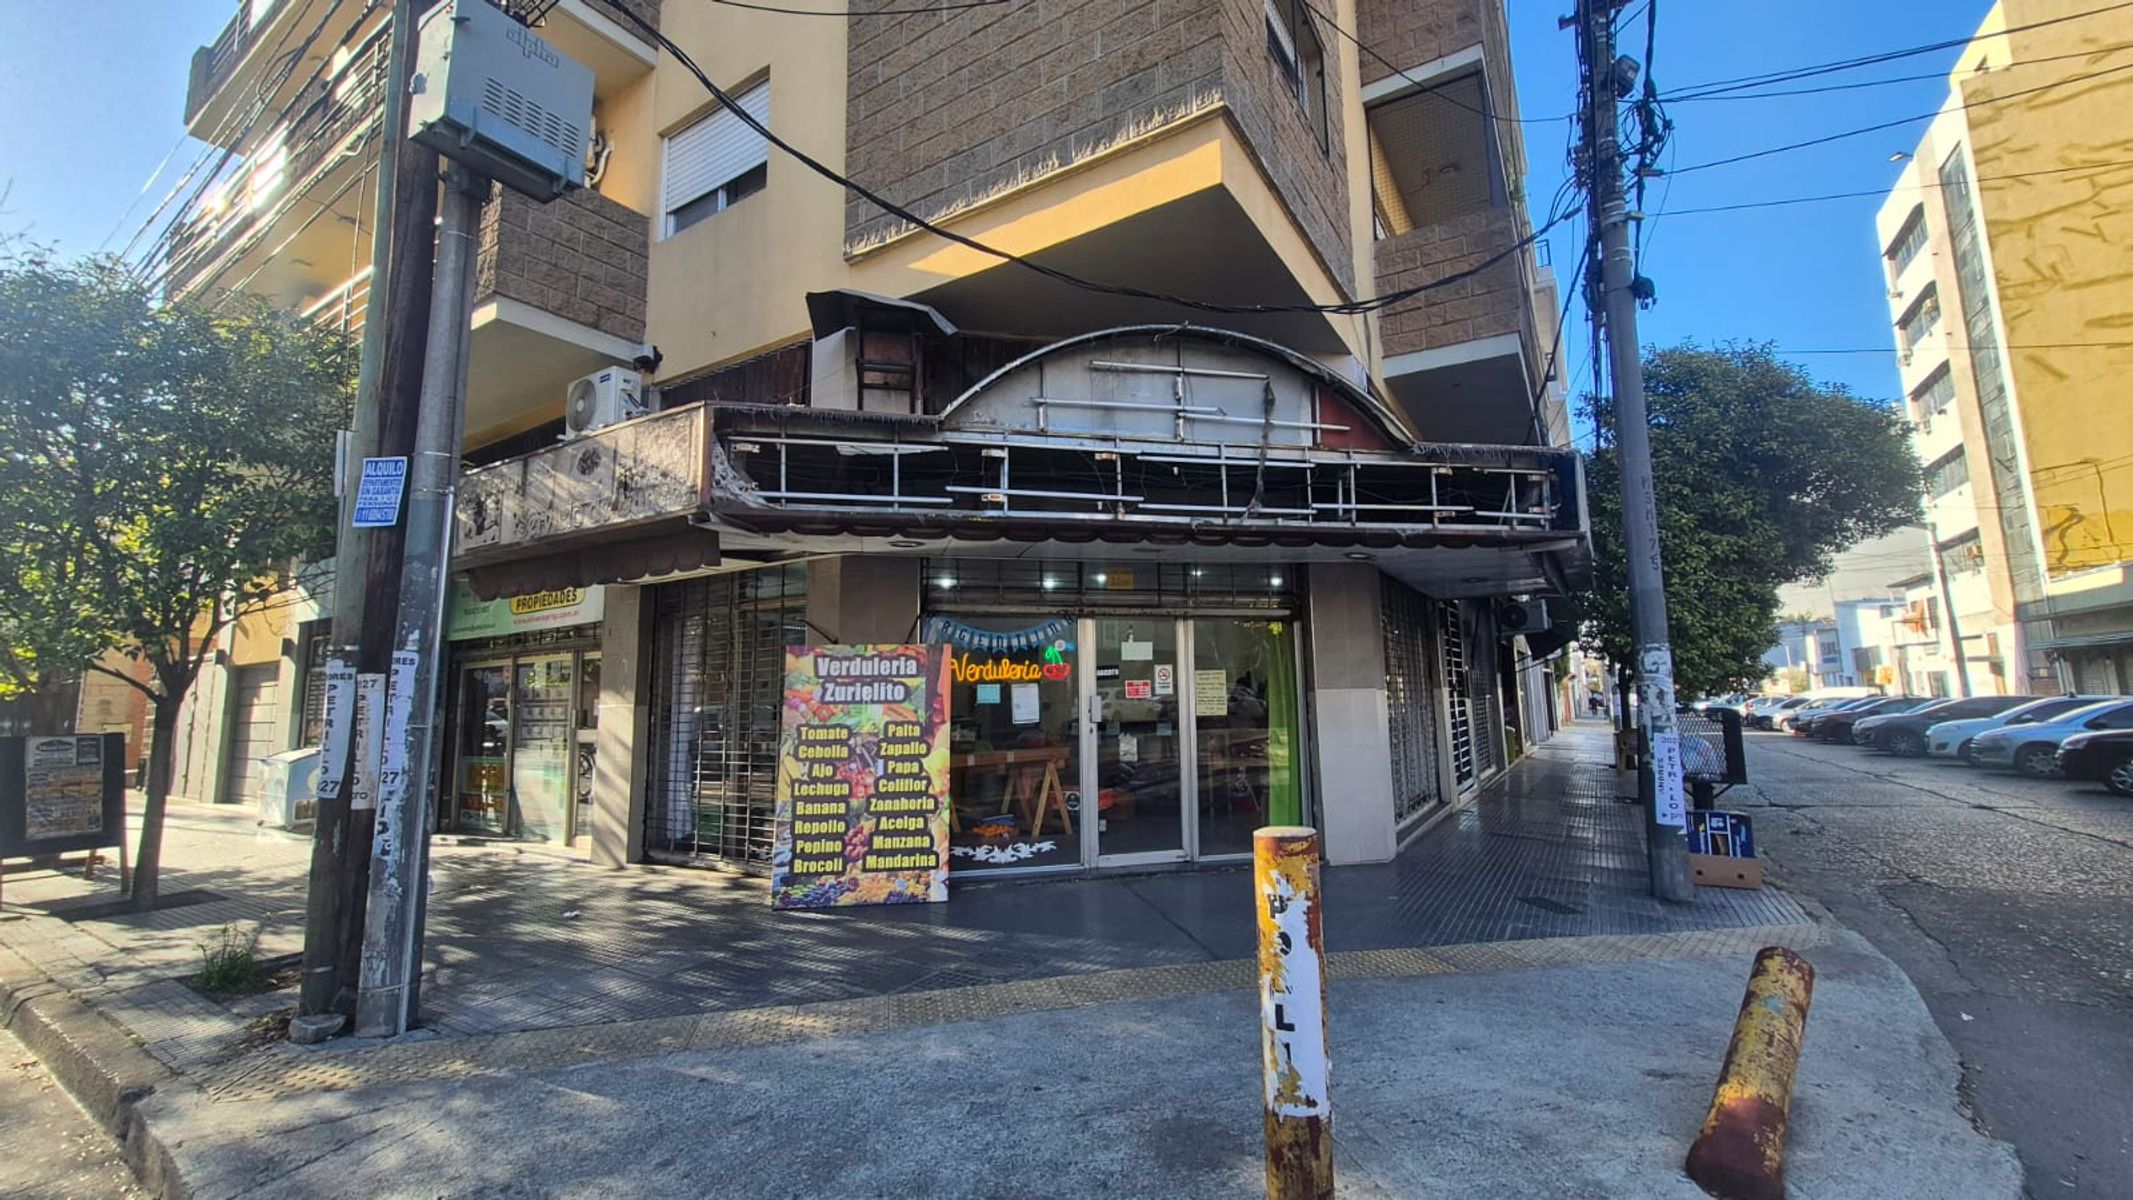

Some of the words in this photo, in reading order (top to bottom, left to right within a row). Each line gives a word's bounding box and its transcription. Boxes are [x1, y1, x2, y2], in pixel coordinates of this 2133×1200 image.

[365, 461, 403, 476] ALQUILO
[516, 589, 577, 611] PROPIEDADES
[816, 656, 917, 676] Verduleria
[824, 682, 905, 702] Zurielito
[800, 726, 848, 740] Tomate
[888, 723, 921, 737] Palta
[799, 744, 849, 759] Cebolla
[879, 741, 928, 757] Zapallo
[812, 763, 833, 779] Ajo
[887, 760, 920, 776] Papa
[794, 781, 850, 799] Lechuga
[878, 777, 928, 793] Coliflor
[796, 801, 846, 816] Banana
[869, 796, 936, 812] Zanahoria
[794, 819, 846, 836] Repollo
[879, 816, 924, 833] Acelga
[796, 838, 843, 855] Pepino
[872, 834, 930, 850] Manzana
[793, 857, 843, 874] Brocoli
[865, 853, 937, 870] Mandarina
